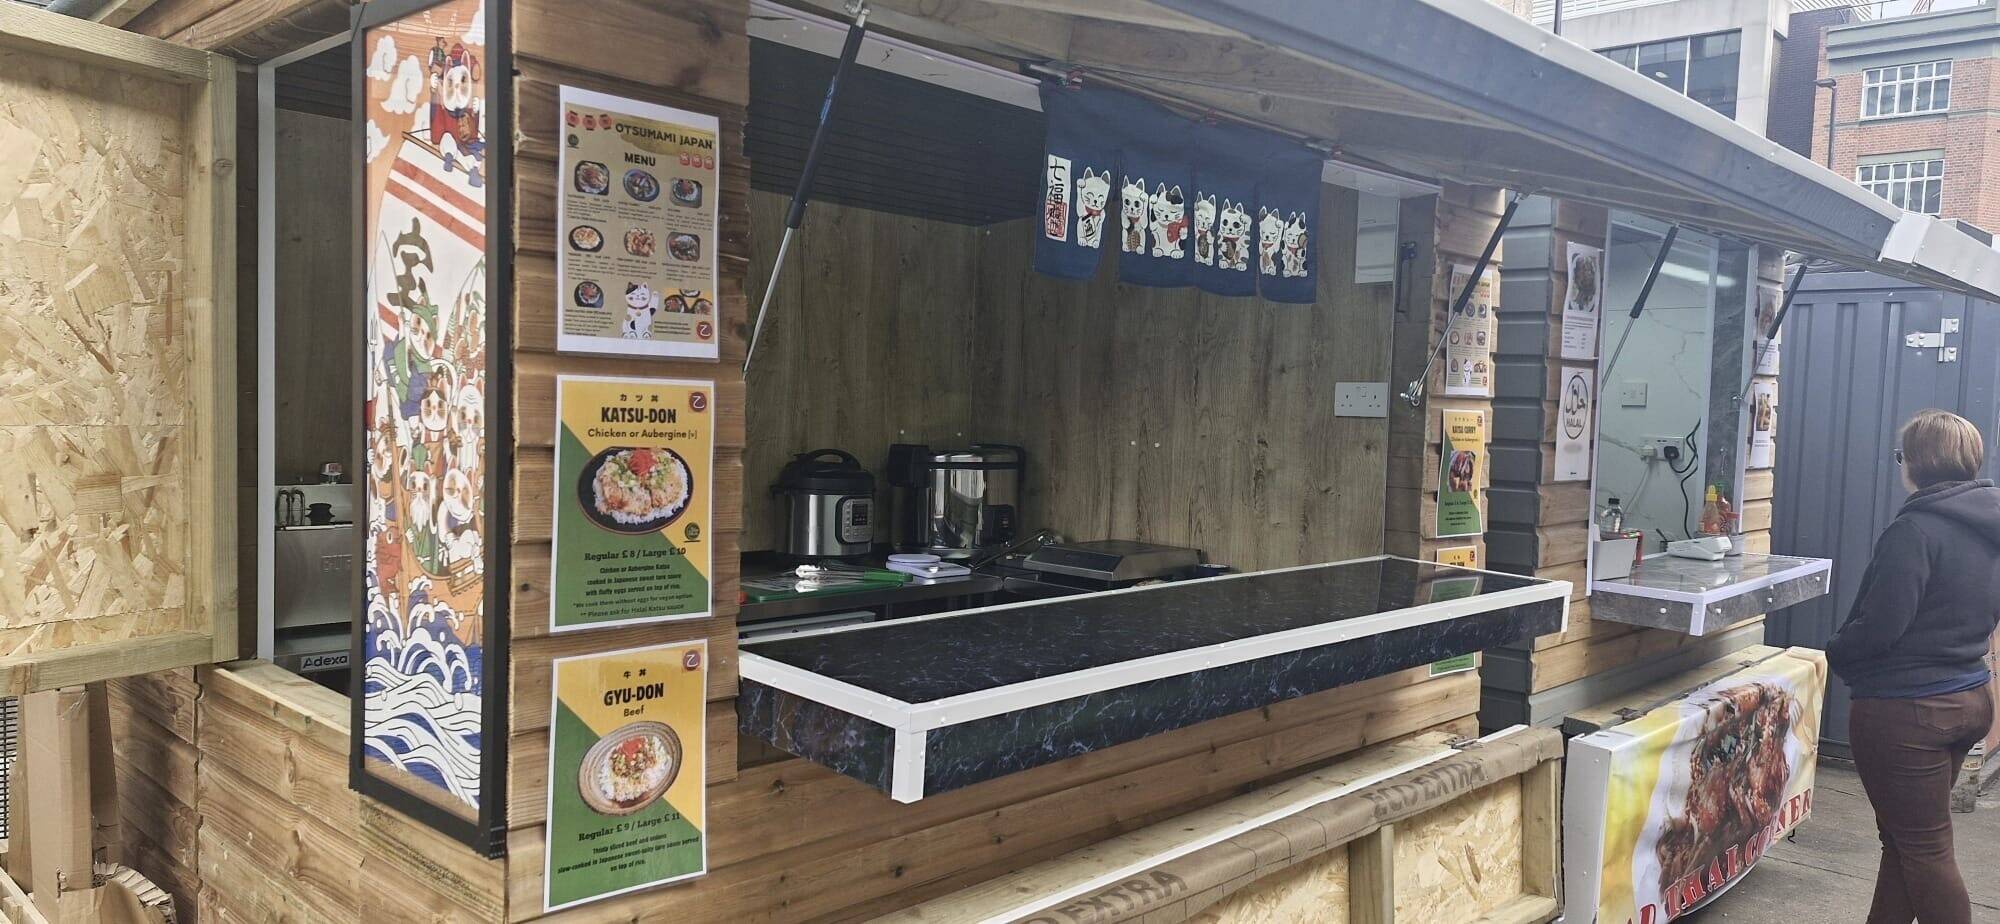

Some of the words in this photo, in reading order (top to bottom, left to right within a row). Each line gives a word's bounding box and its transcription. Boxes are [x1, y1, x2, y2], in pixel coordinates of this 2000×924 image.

[616, 123, 676, 143] OTSUMAMI
[679, 135, 713, 150] JAPAN
[624, 152, 656, 167] MENU
[601, 406, 677, 423] KATSU-DON
[587, 428, 627, 438] Chicken
[641, 429, 687, 440] Aubergine
[584, 549, 620, 562] Regular
[643, 547, 667, 559] Large
[303, 654, 348, 669] Adexa
[603, 682, 664, 706] GYU-DON
[623, 704, 644, 717] Beef
[578, 826, 615, 842] Regular
[637, 816, 662, 829] Large
[1664, 843, 1739, 921] THAI
